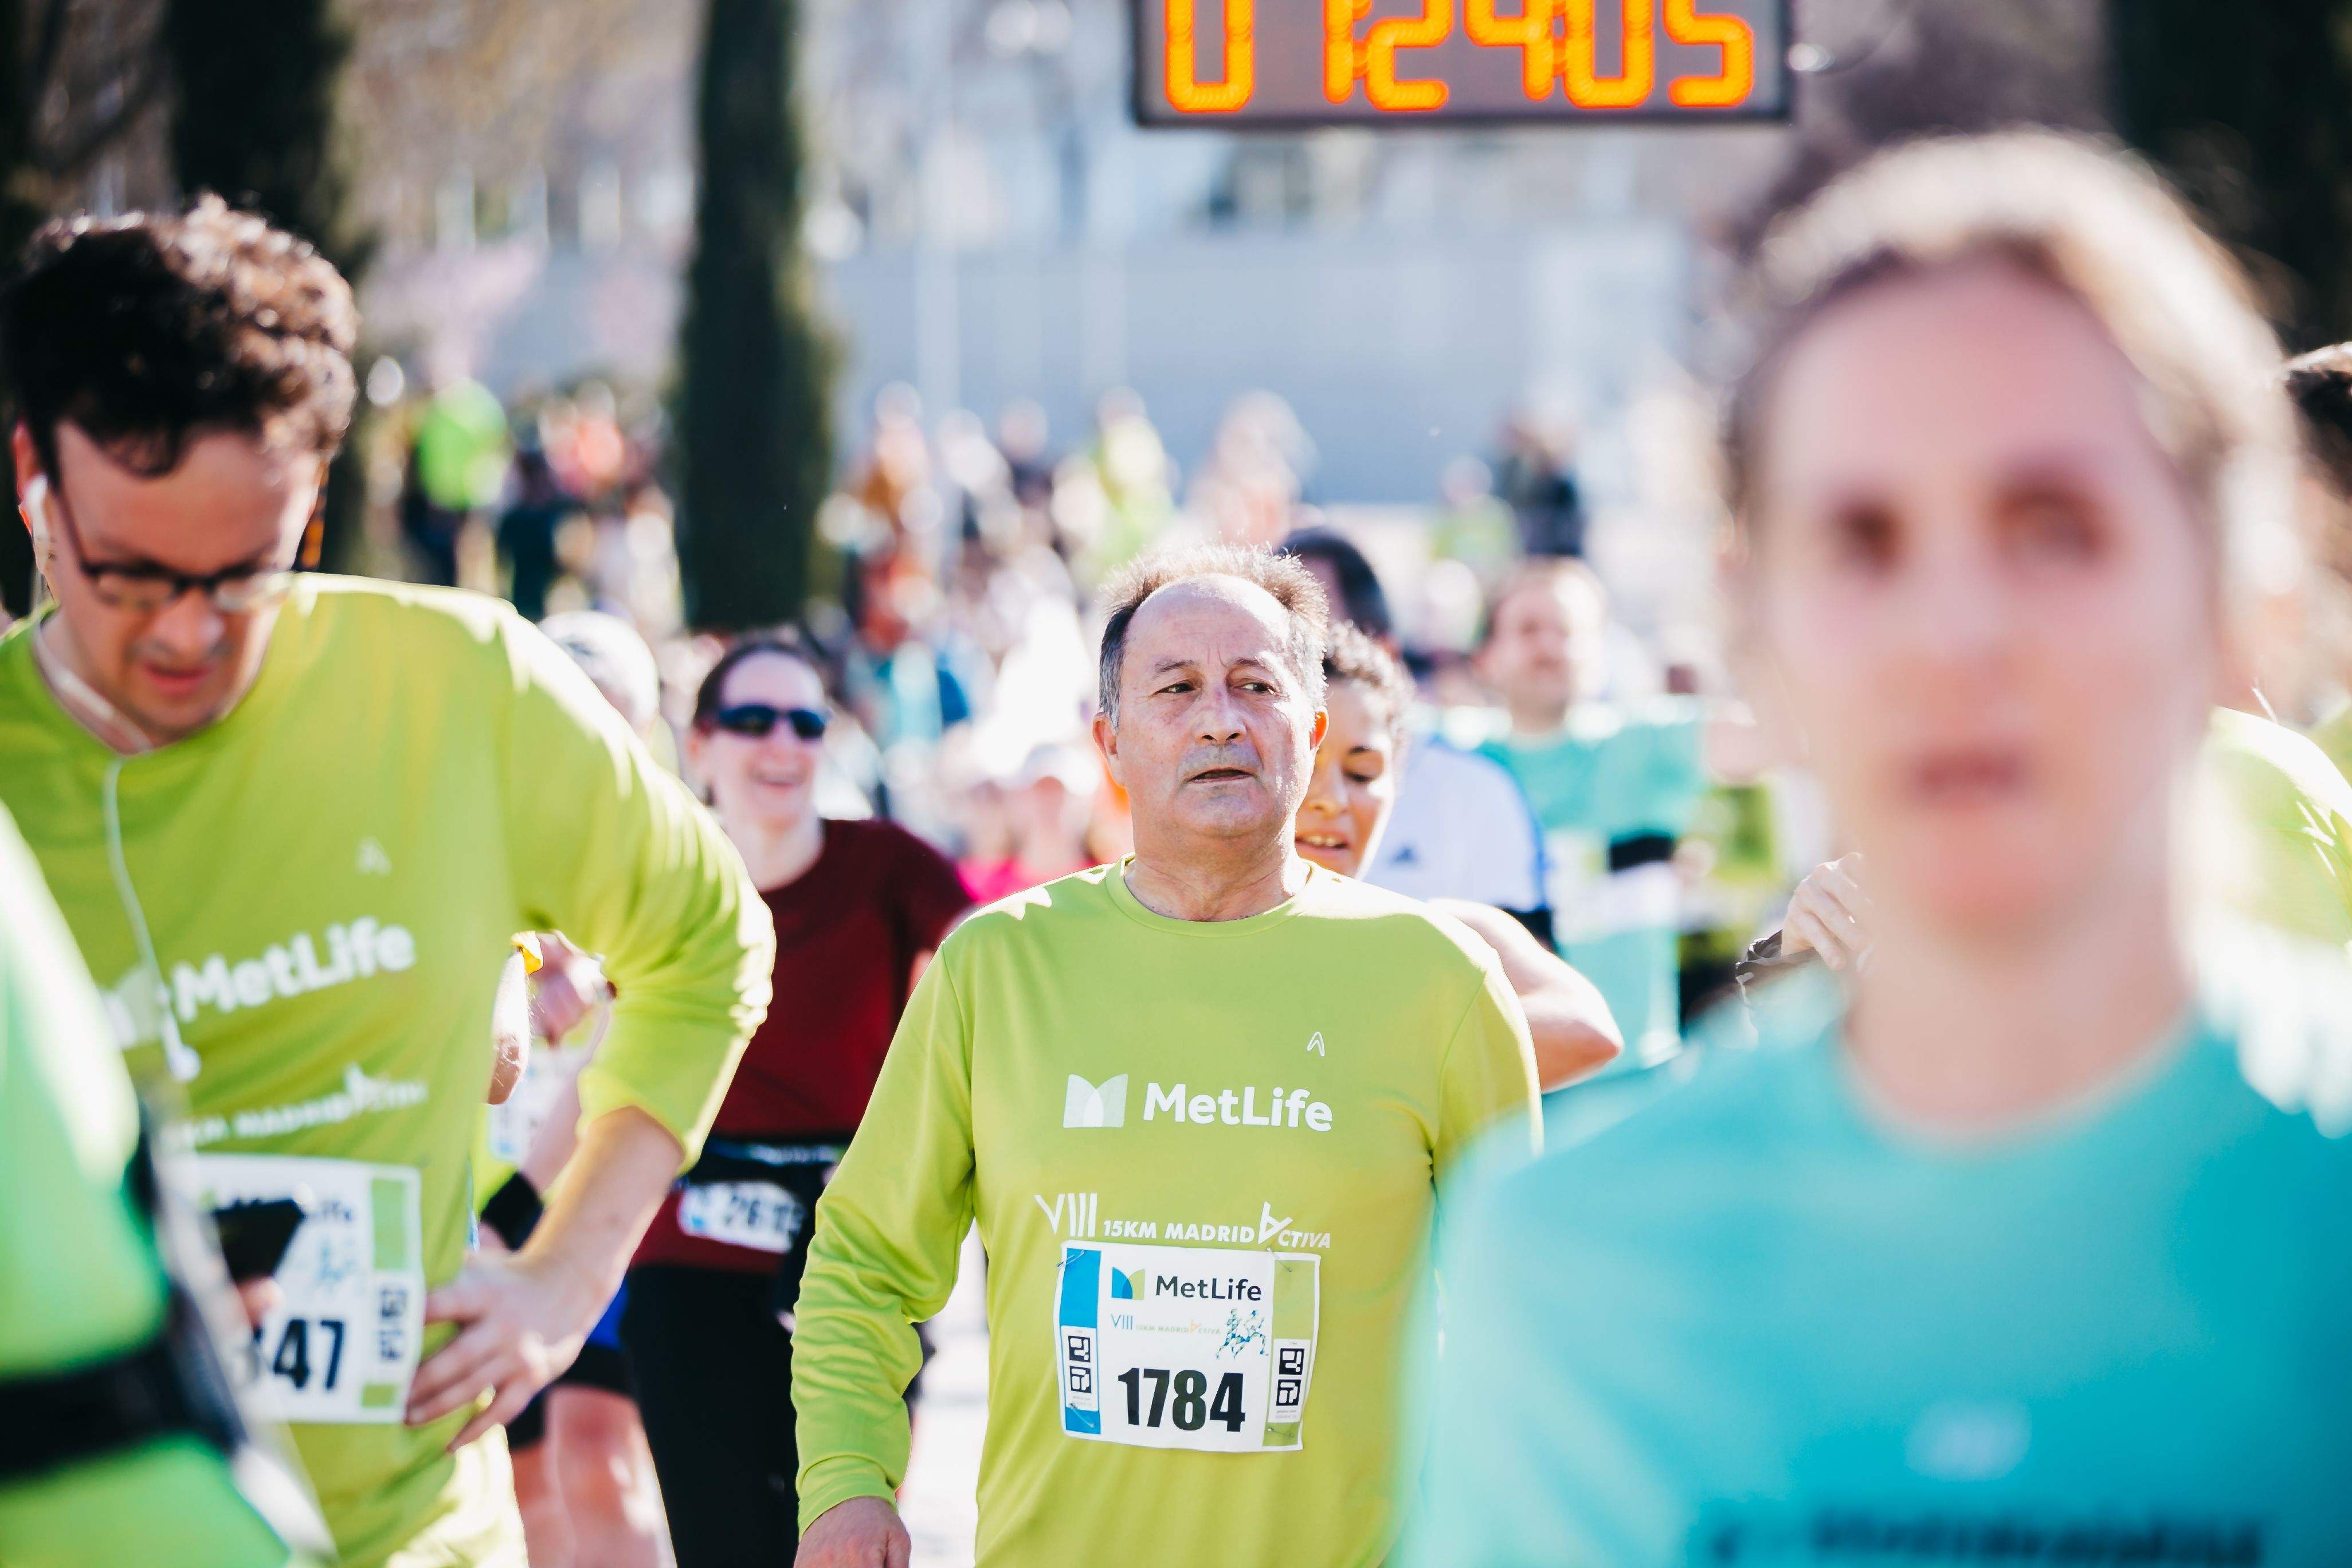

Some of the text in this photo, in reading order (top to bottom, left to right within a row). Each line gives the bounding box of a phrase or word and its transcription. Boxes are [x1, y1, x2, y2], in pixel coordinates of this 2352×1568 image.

[173, 915, 417, 1023] MetLife
[1143, 1082, 1334, 1132] MetLife
[1034, 1192, 1098, 1238] VIII
[1103, 1219, 1158, 1239] 15KM
[1164, 1222, 1255, 1244] MADRID
[1155, 1275, 1261, 1302] MetLife
[1110, 1313, 1134, 1330] VIII
[253, 1318, 345, 1391] 47
[1117, 1367, 1246, 1432] 1784
